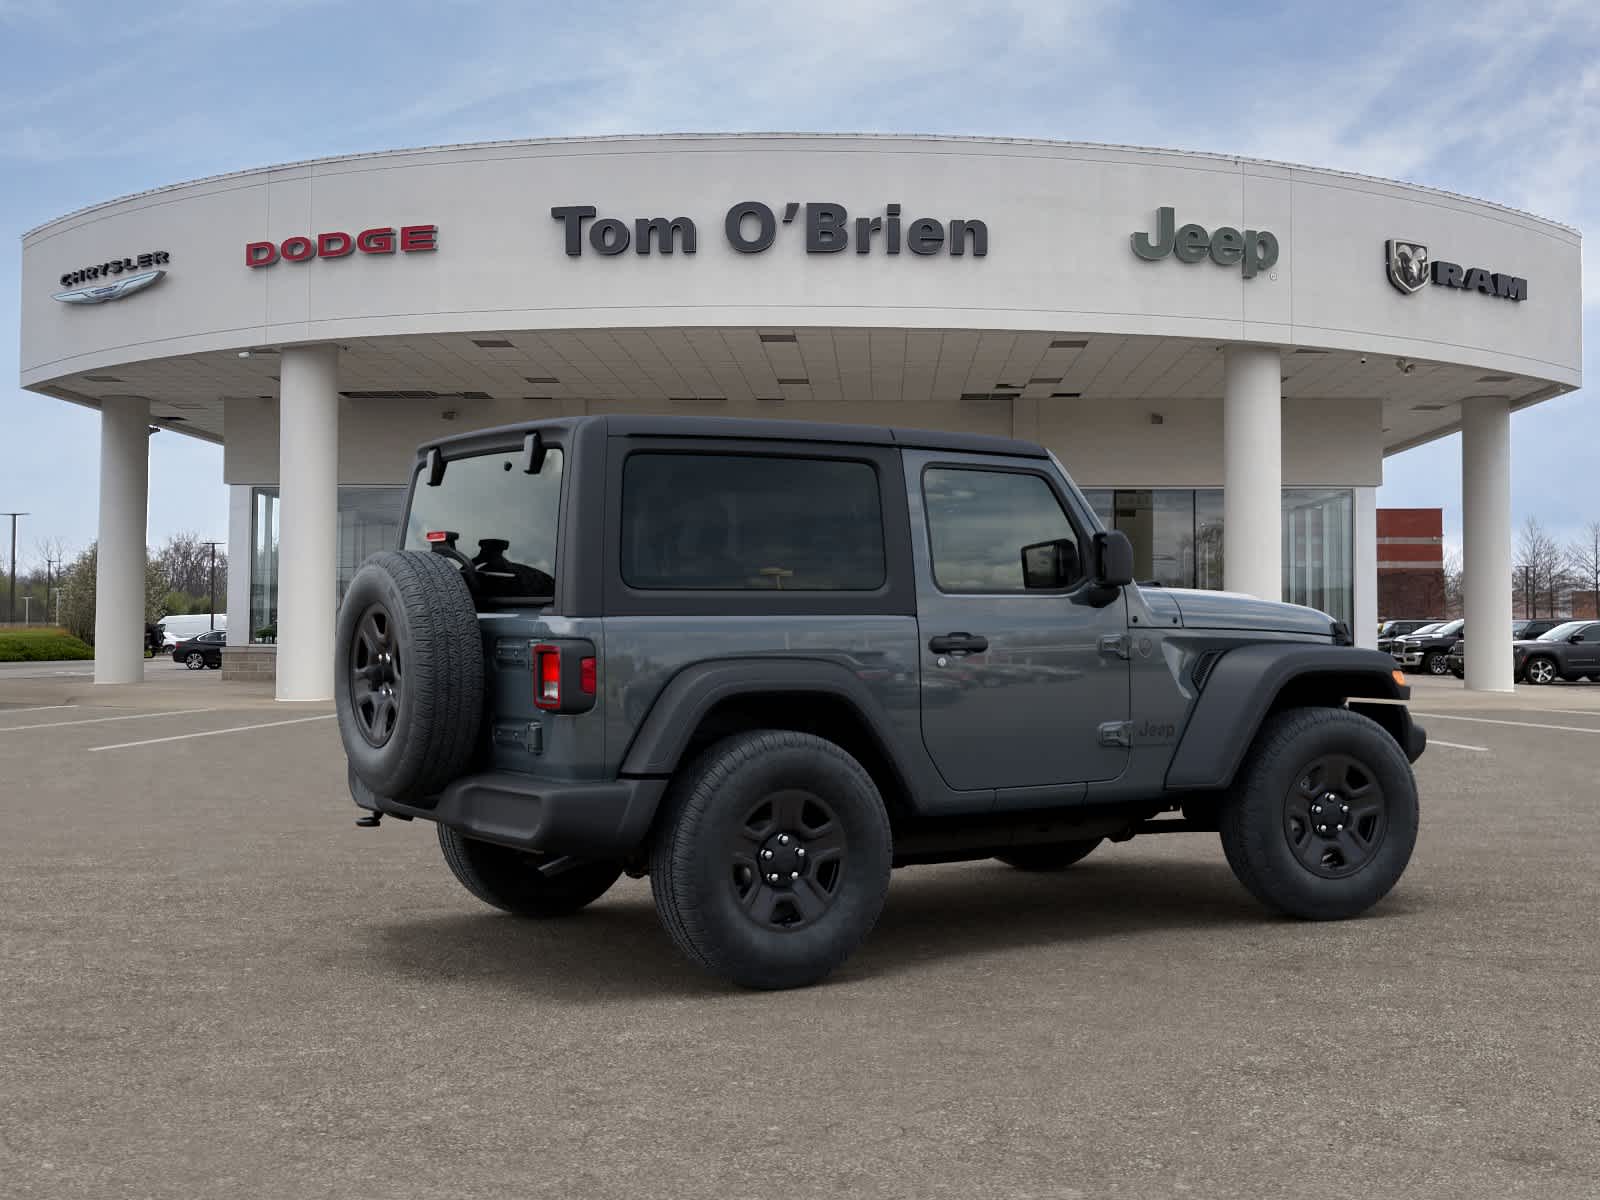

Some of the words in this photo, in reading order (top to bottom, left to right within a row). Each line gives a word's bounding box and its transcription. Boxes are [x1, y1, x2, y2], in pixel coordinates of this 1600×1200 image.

[245, 224, 437, 268] DODGE
[551, 205, 697, 256] Tom
[725, 201, 988, 256] O’Brien
[1130, 206, 1280, 279] Jeep
[60, 250, 170, 287] CHRYSLER
[1431, 260, 1528, 302] RAM
[1138, 720, 1176, 738] Jeep
